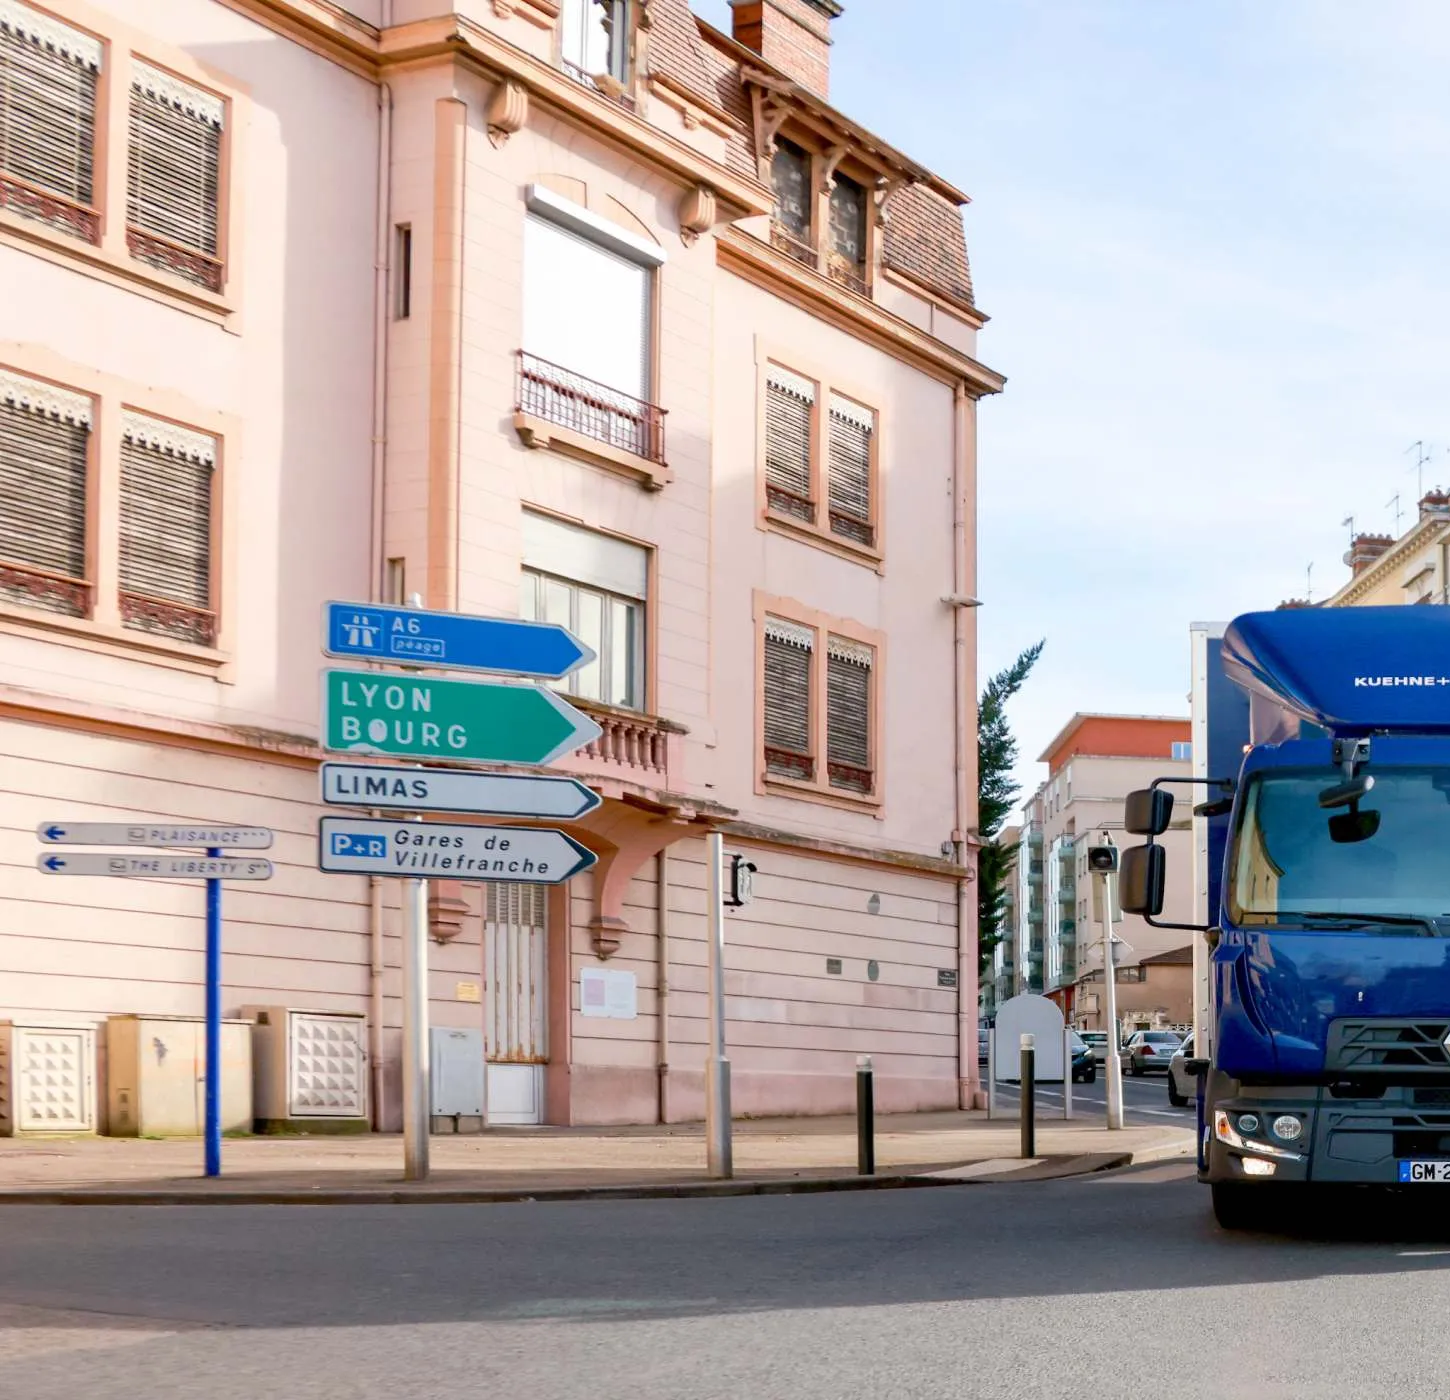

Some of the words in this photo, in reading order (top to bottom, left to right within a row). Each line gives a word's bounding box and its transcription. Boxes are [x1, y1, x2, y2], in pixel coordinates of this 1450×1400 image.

[391, 616, 421, 634] A6
[341, 681, 432, 712] LYON
[341, 716, 467, 748] BOURG
[336, 774, 428, 799] LIMAS
[334, 835, 384, 857] P+R
[394, 829, 464, 848] Gares
[484, 835, 511, 851] de
[130, 860, 160, 872] THE
[394, 850, 549, 874] Villefranche
